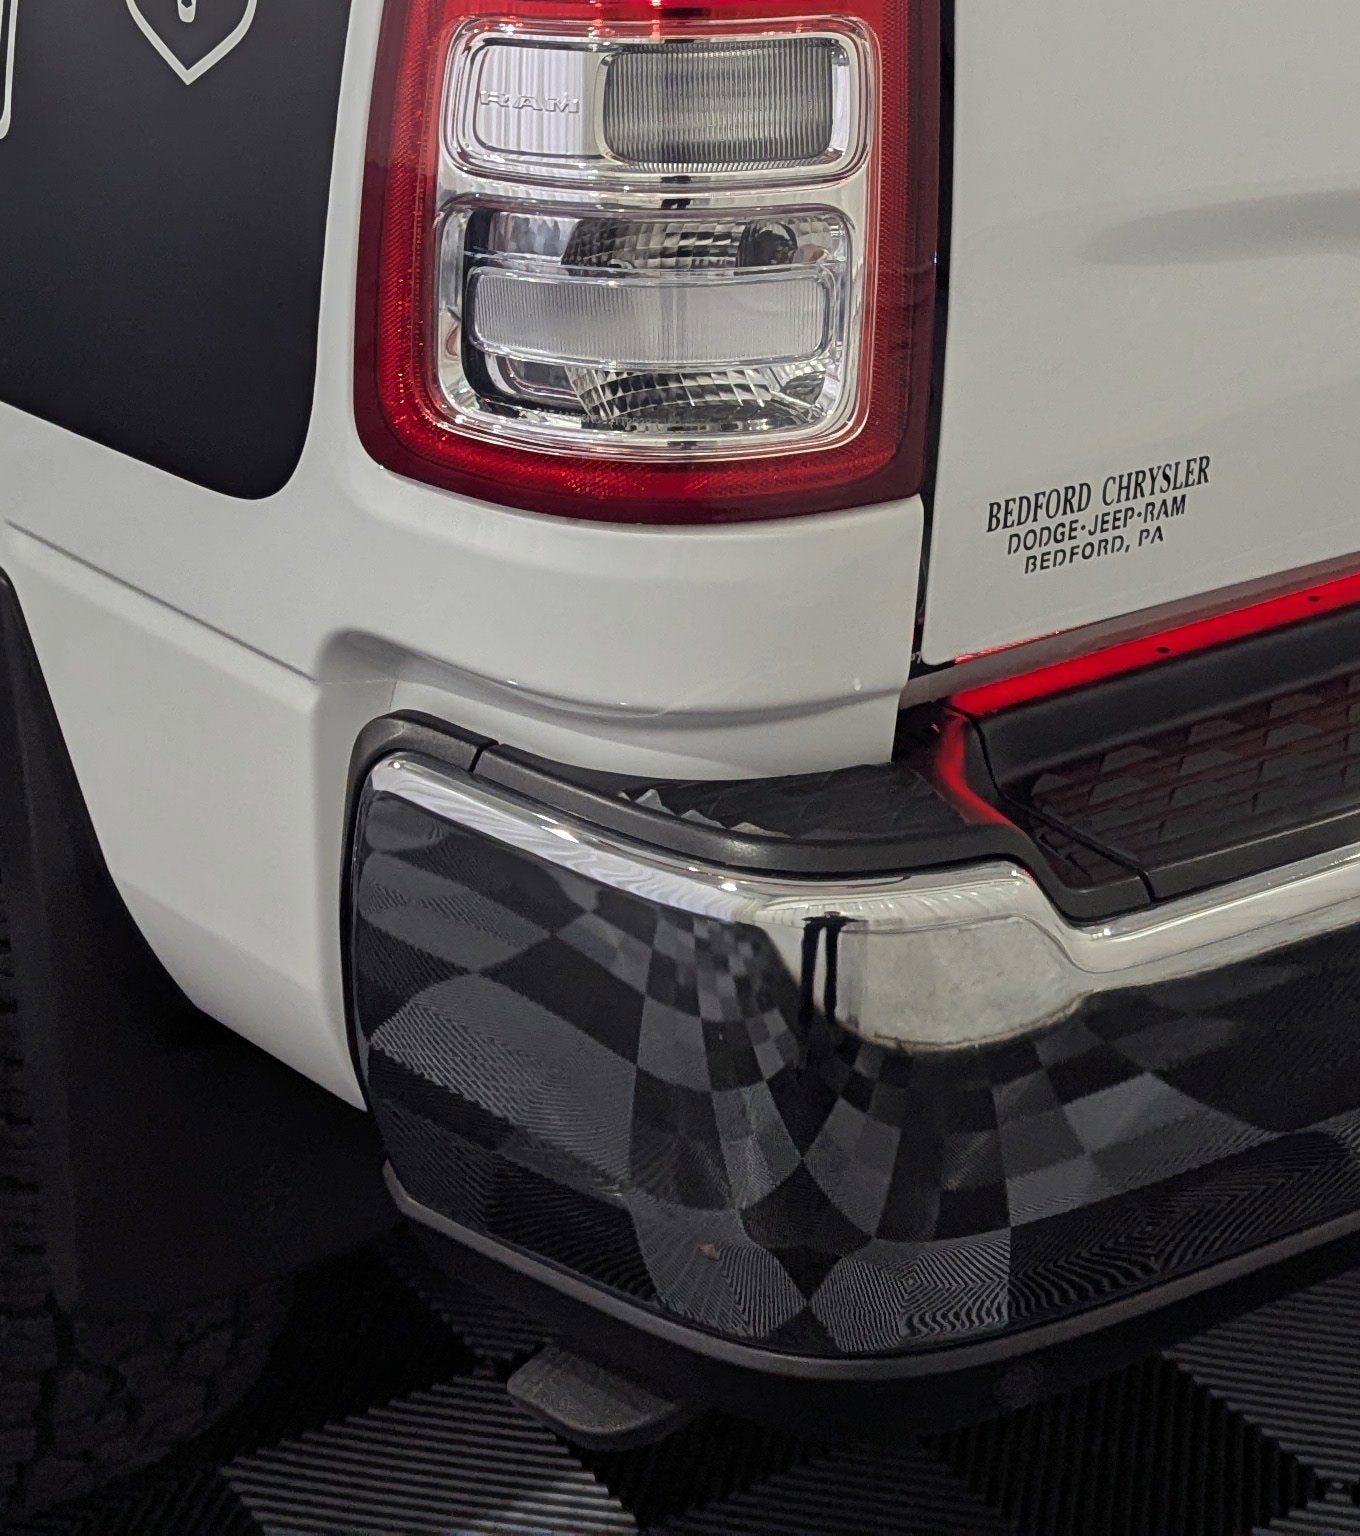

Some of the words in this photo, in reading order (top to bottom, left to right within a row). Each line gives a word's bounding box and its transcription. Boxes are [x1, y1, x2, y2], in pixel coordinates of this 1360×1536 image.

[480, 90, 580, 115] RAM
[986, 482, 1092, 533] BEDFORD
[1101, 455, 1211, 507] CHRYSLER
[1023, 534, 1131, 575] BEDFORD,
[1137, 525, 1165, 548] PA
